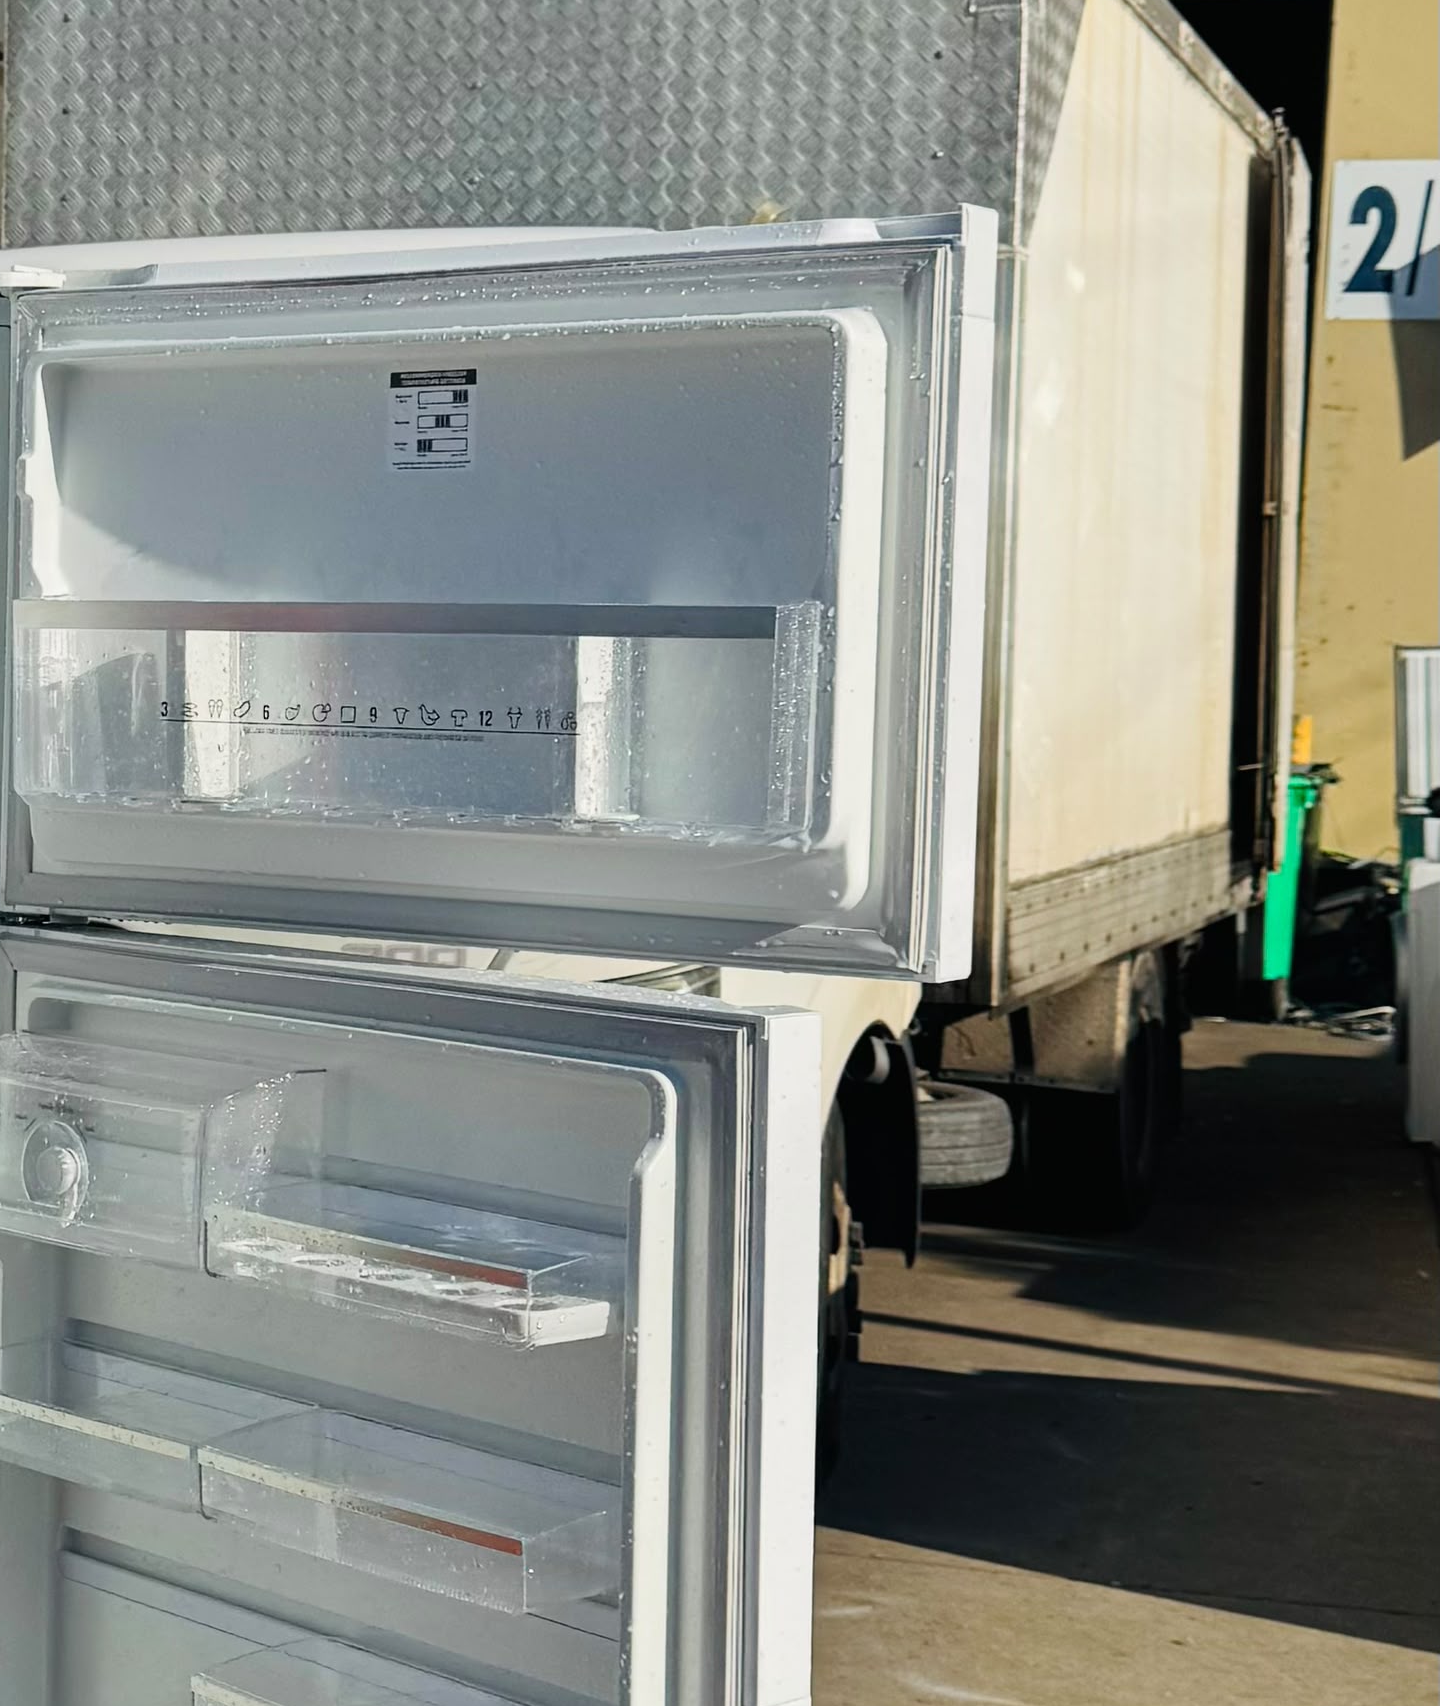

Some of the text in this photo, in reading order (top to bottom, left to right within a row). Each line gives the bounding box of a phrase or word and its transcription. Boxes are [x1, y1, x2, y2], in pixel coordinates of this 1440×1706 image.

[160, 701, 493, 727] 3 6 9 12
